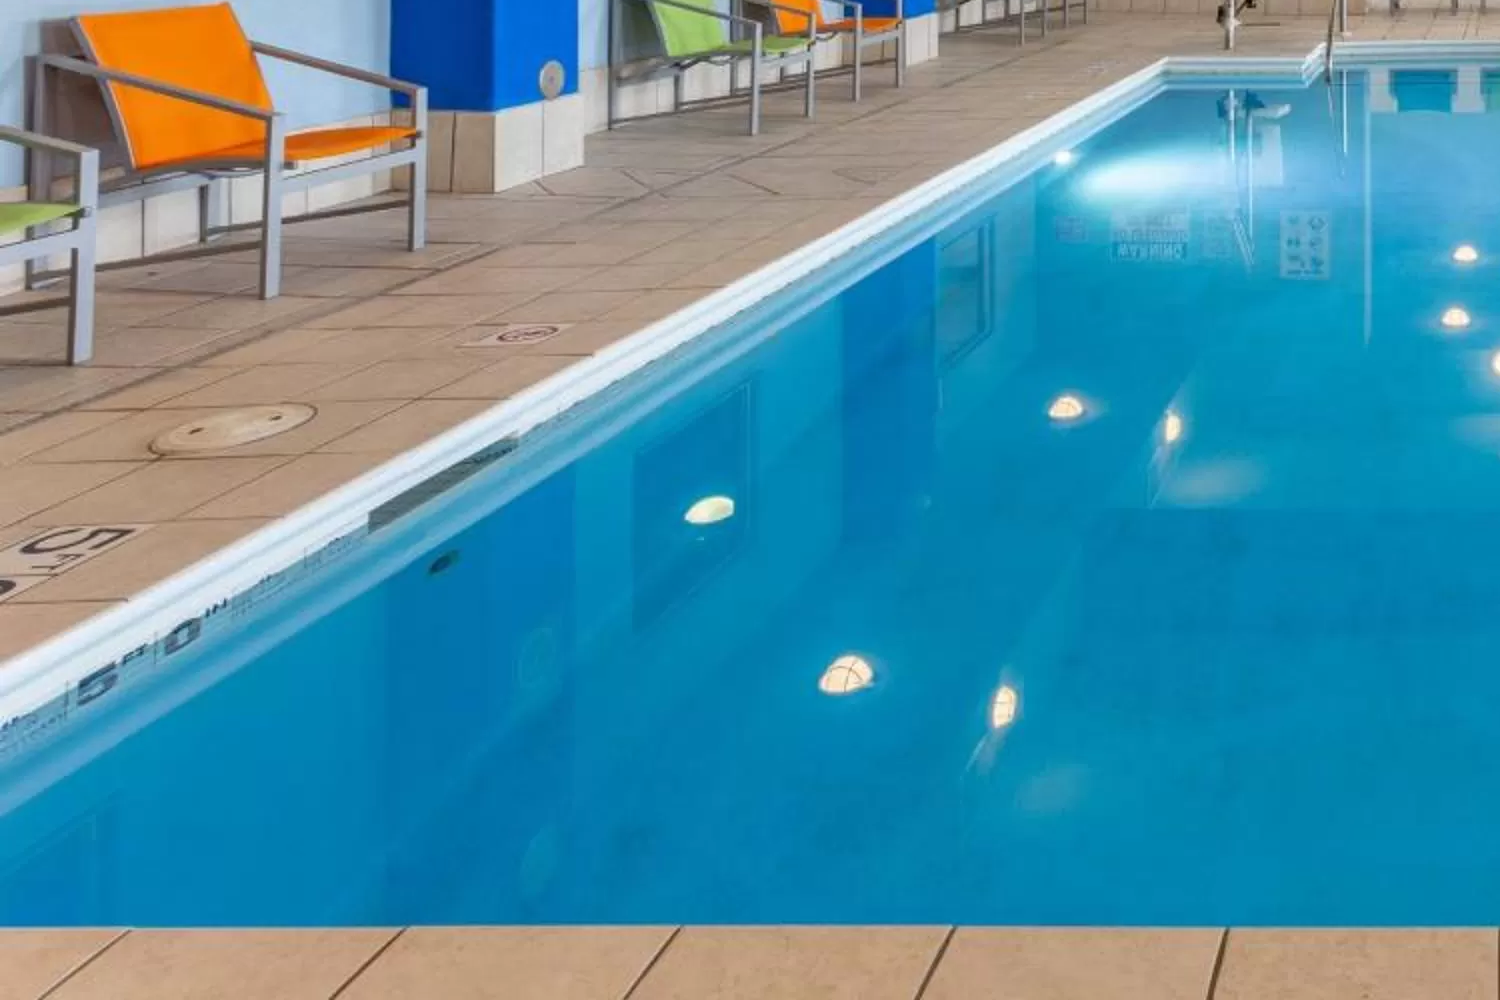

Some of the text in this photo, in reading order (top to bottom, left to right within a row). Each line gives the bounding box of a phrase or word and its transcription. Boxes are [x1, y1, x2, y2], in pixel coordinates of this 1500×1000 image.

[20, 527, 136, 555] 5
[77, 661, 118, 707] 5
[163, 617, 202, 656] 0
